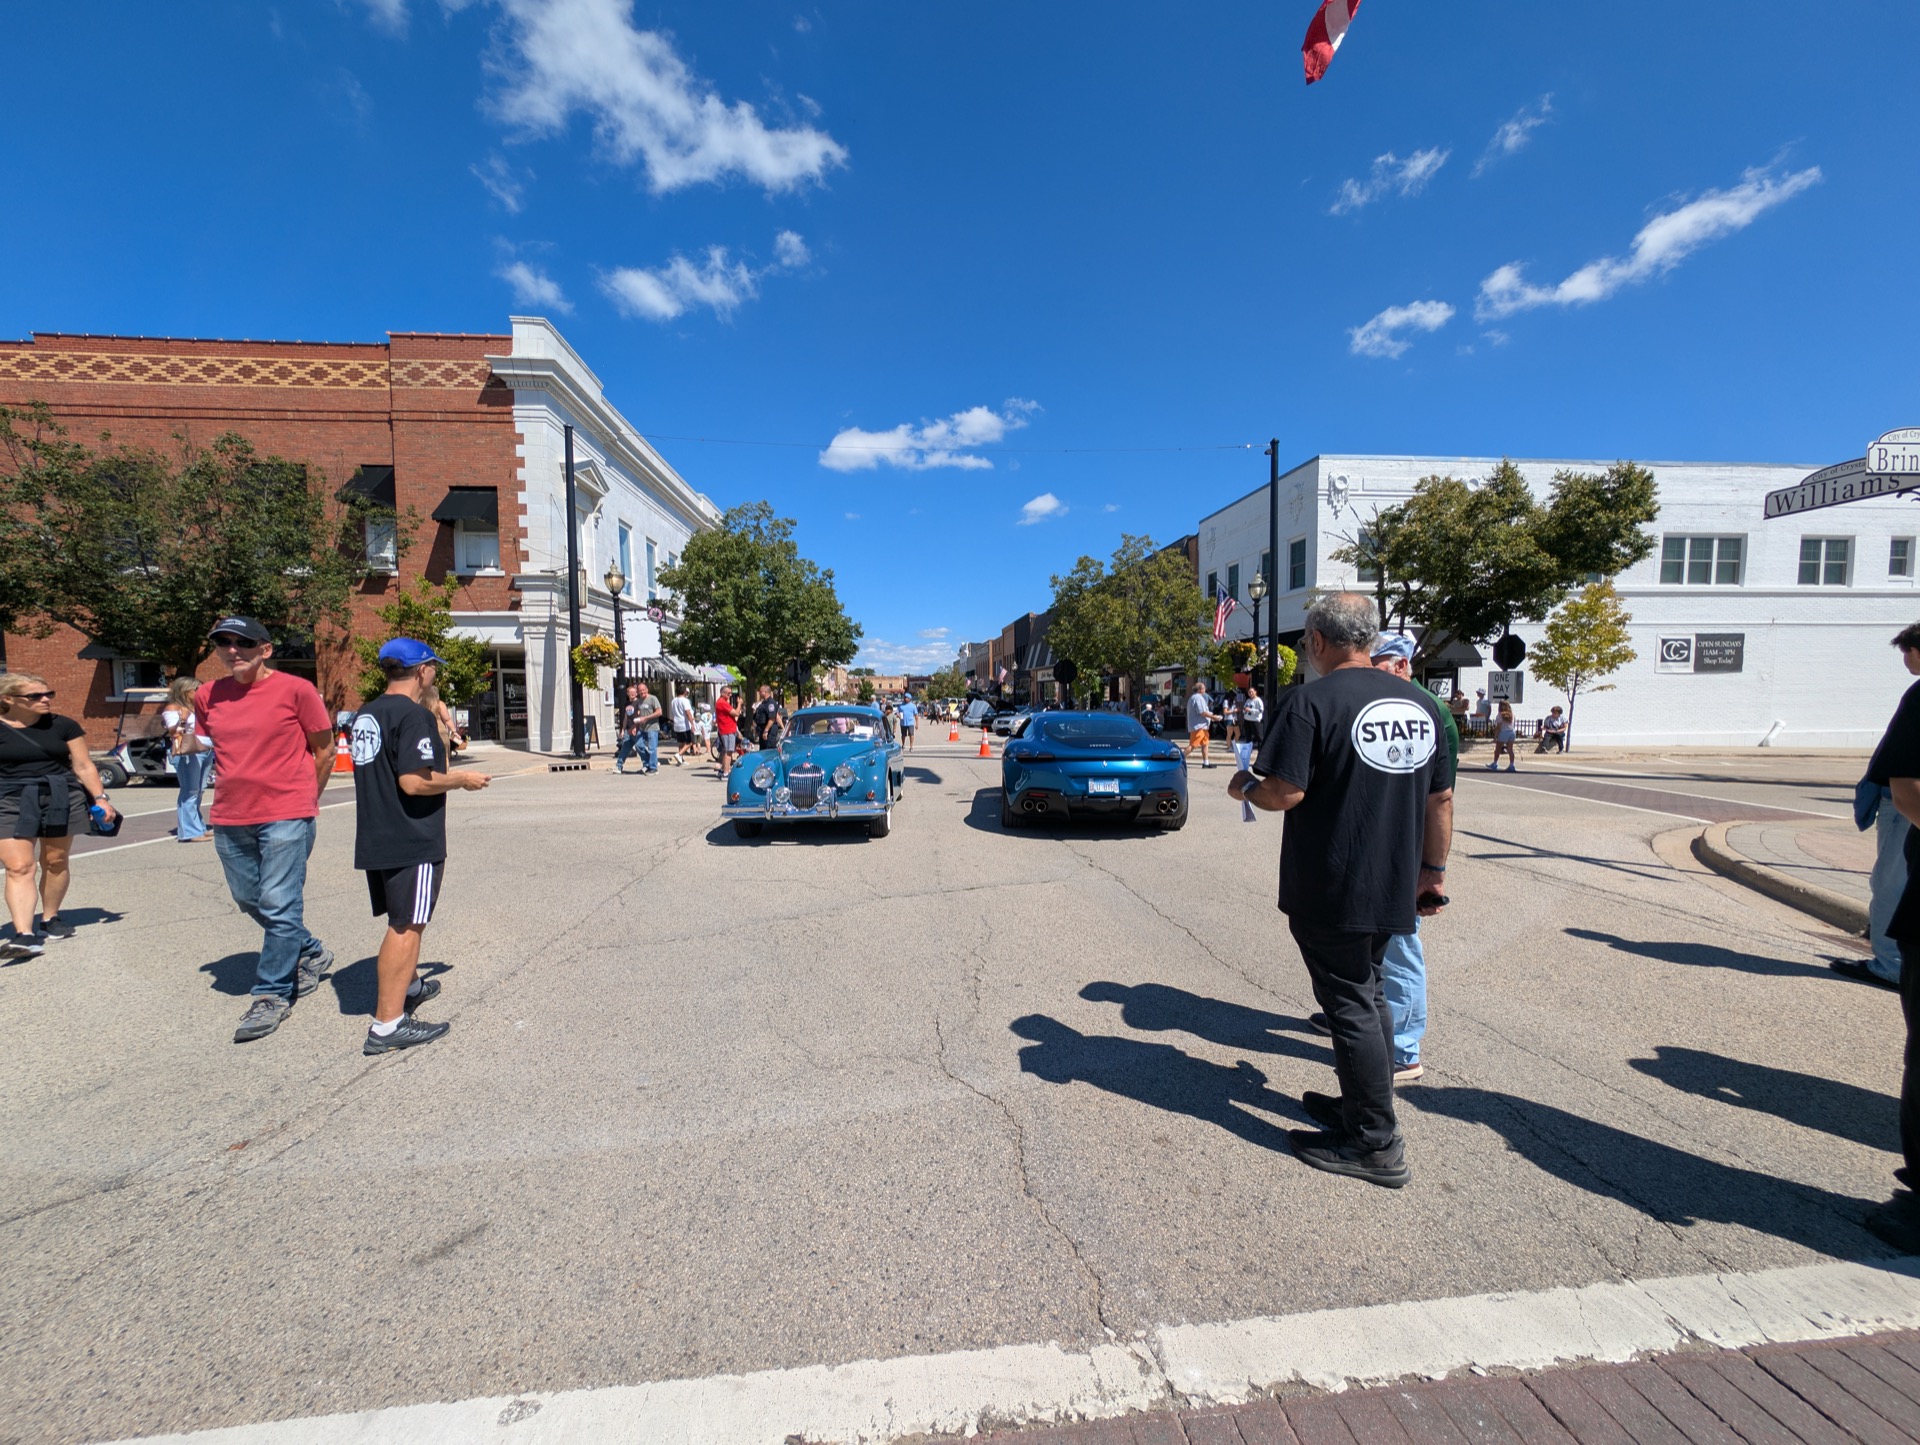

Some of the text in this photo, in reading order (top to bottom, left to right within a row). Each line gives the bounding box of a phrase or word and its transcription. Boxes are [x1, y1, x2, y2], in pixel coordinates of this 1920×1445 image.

[1888, 433, 1900, 441] City
[1876, 446, 1919, 471] Brin
[1812, 471, 1828, 482] City
[1831, 467, 1838, 475] of
[1774, 475, 1900, 513] Williams
[1704, 657, 1734, 665] Shop Today!
[1494, 674, 1509, 682] ONE
[1493, 684, 1510, 693] WAY
[1361, 720, 1430, 743] STAFF
